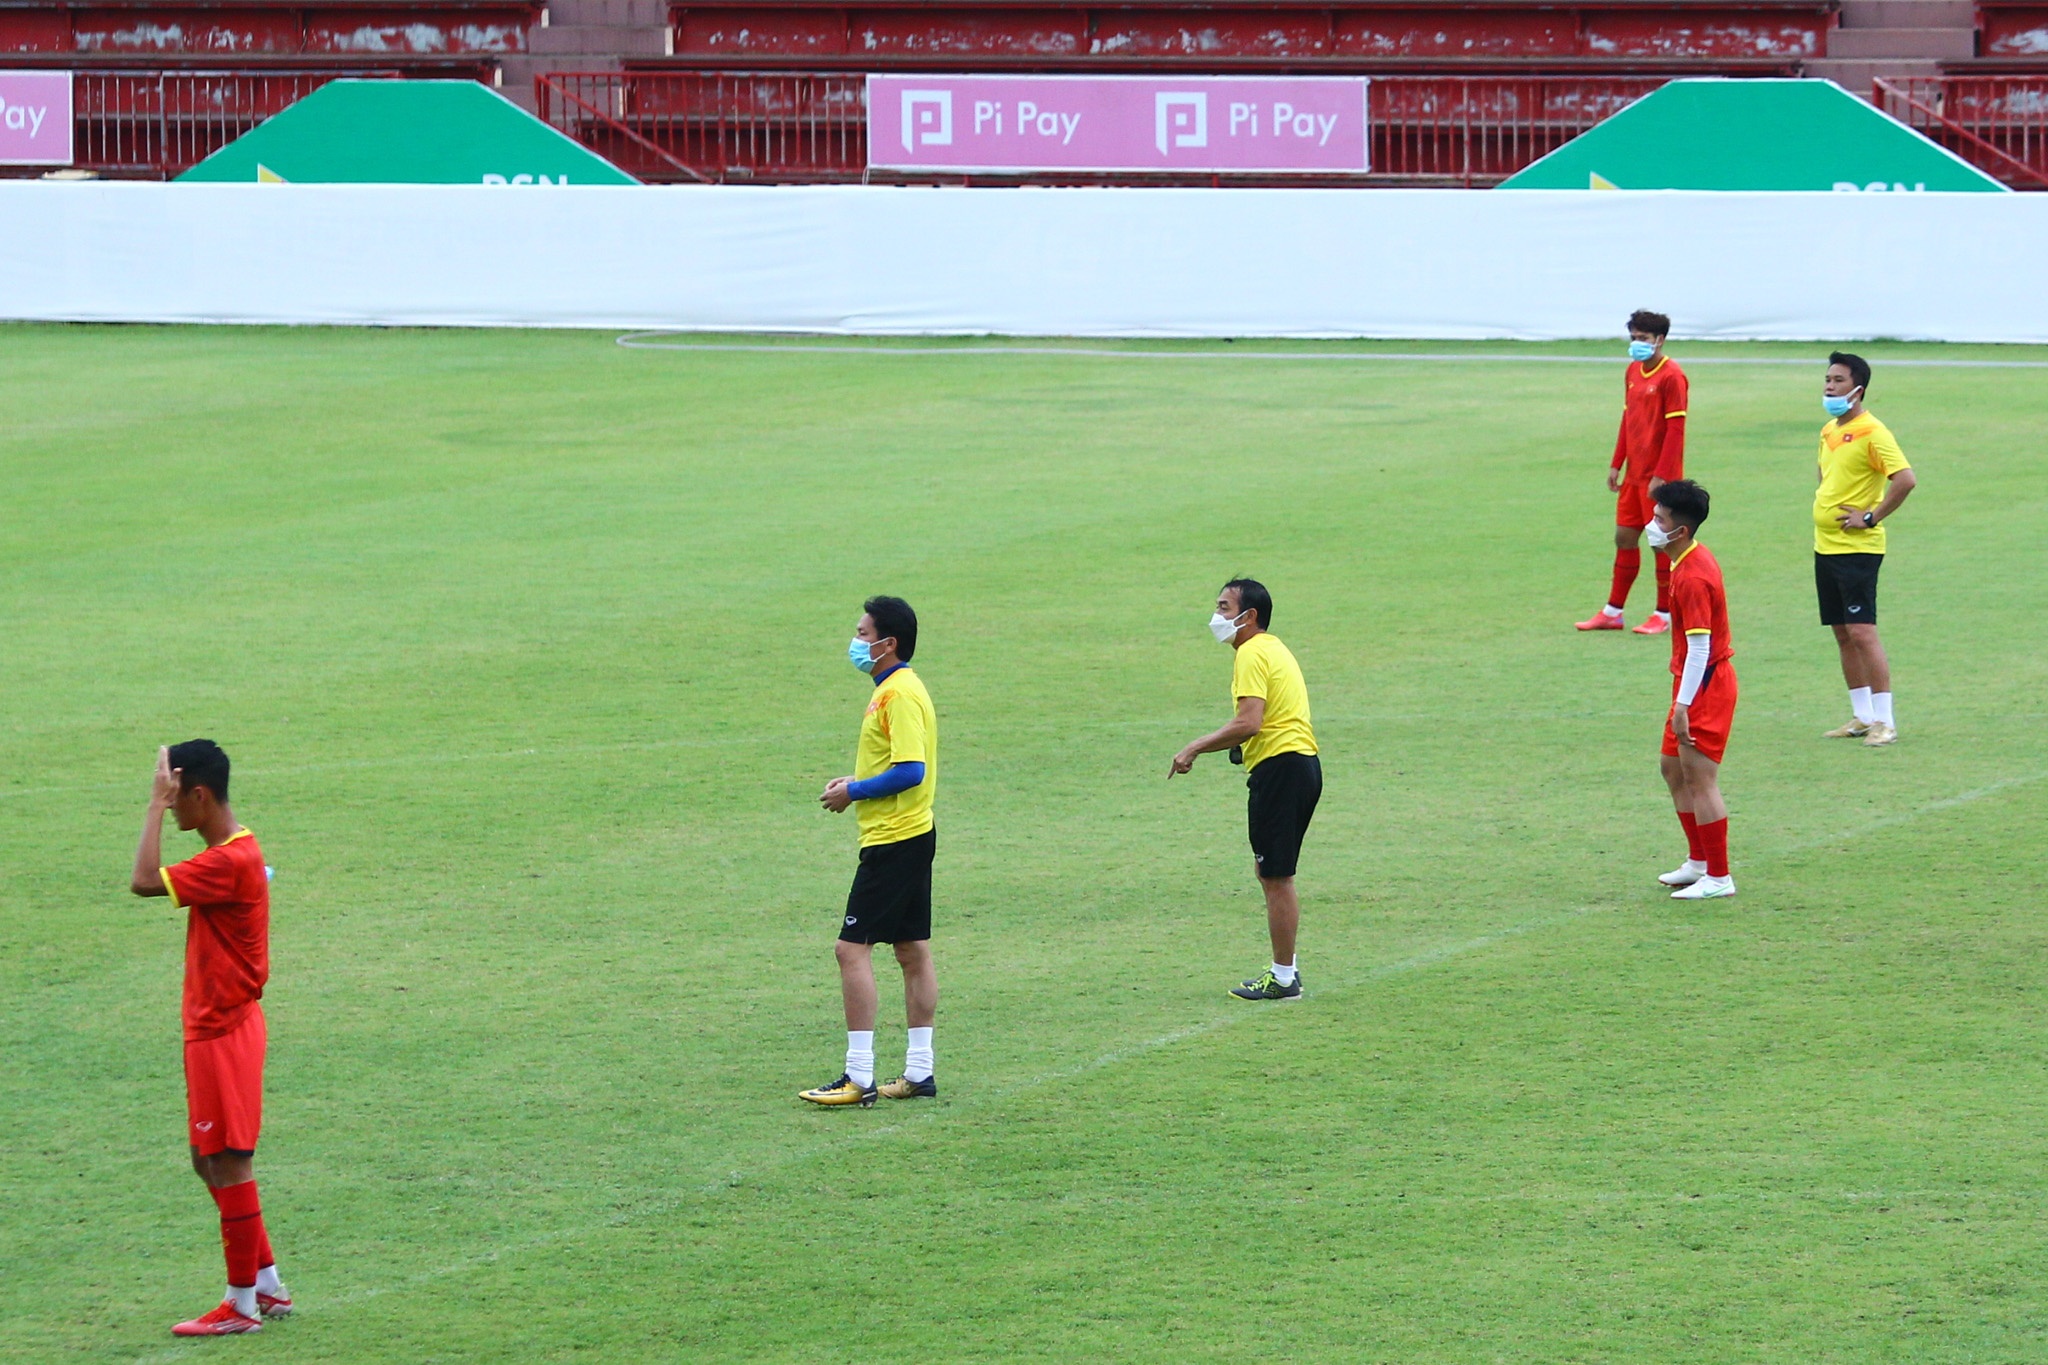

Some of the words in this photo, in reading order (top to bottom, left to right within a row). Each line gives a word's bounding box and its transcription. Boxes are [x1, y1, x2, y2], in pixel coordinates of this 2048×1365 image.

[974, 100, 1003, 136] Pi
[1017, 100, 1082, 146] Pay
[1229, 101, 1259, 137] Pi
[1273, 101, 1339, 147] Pay
